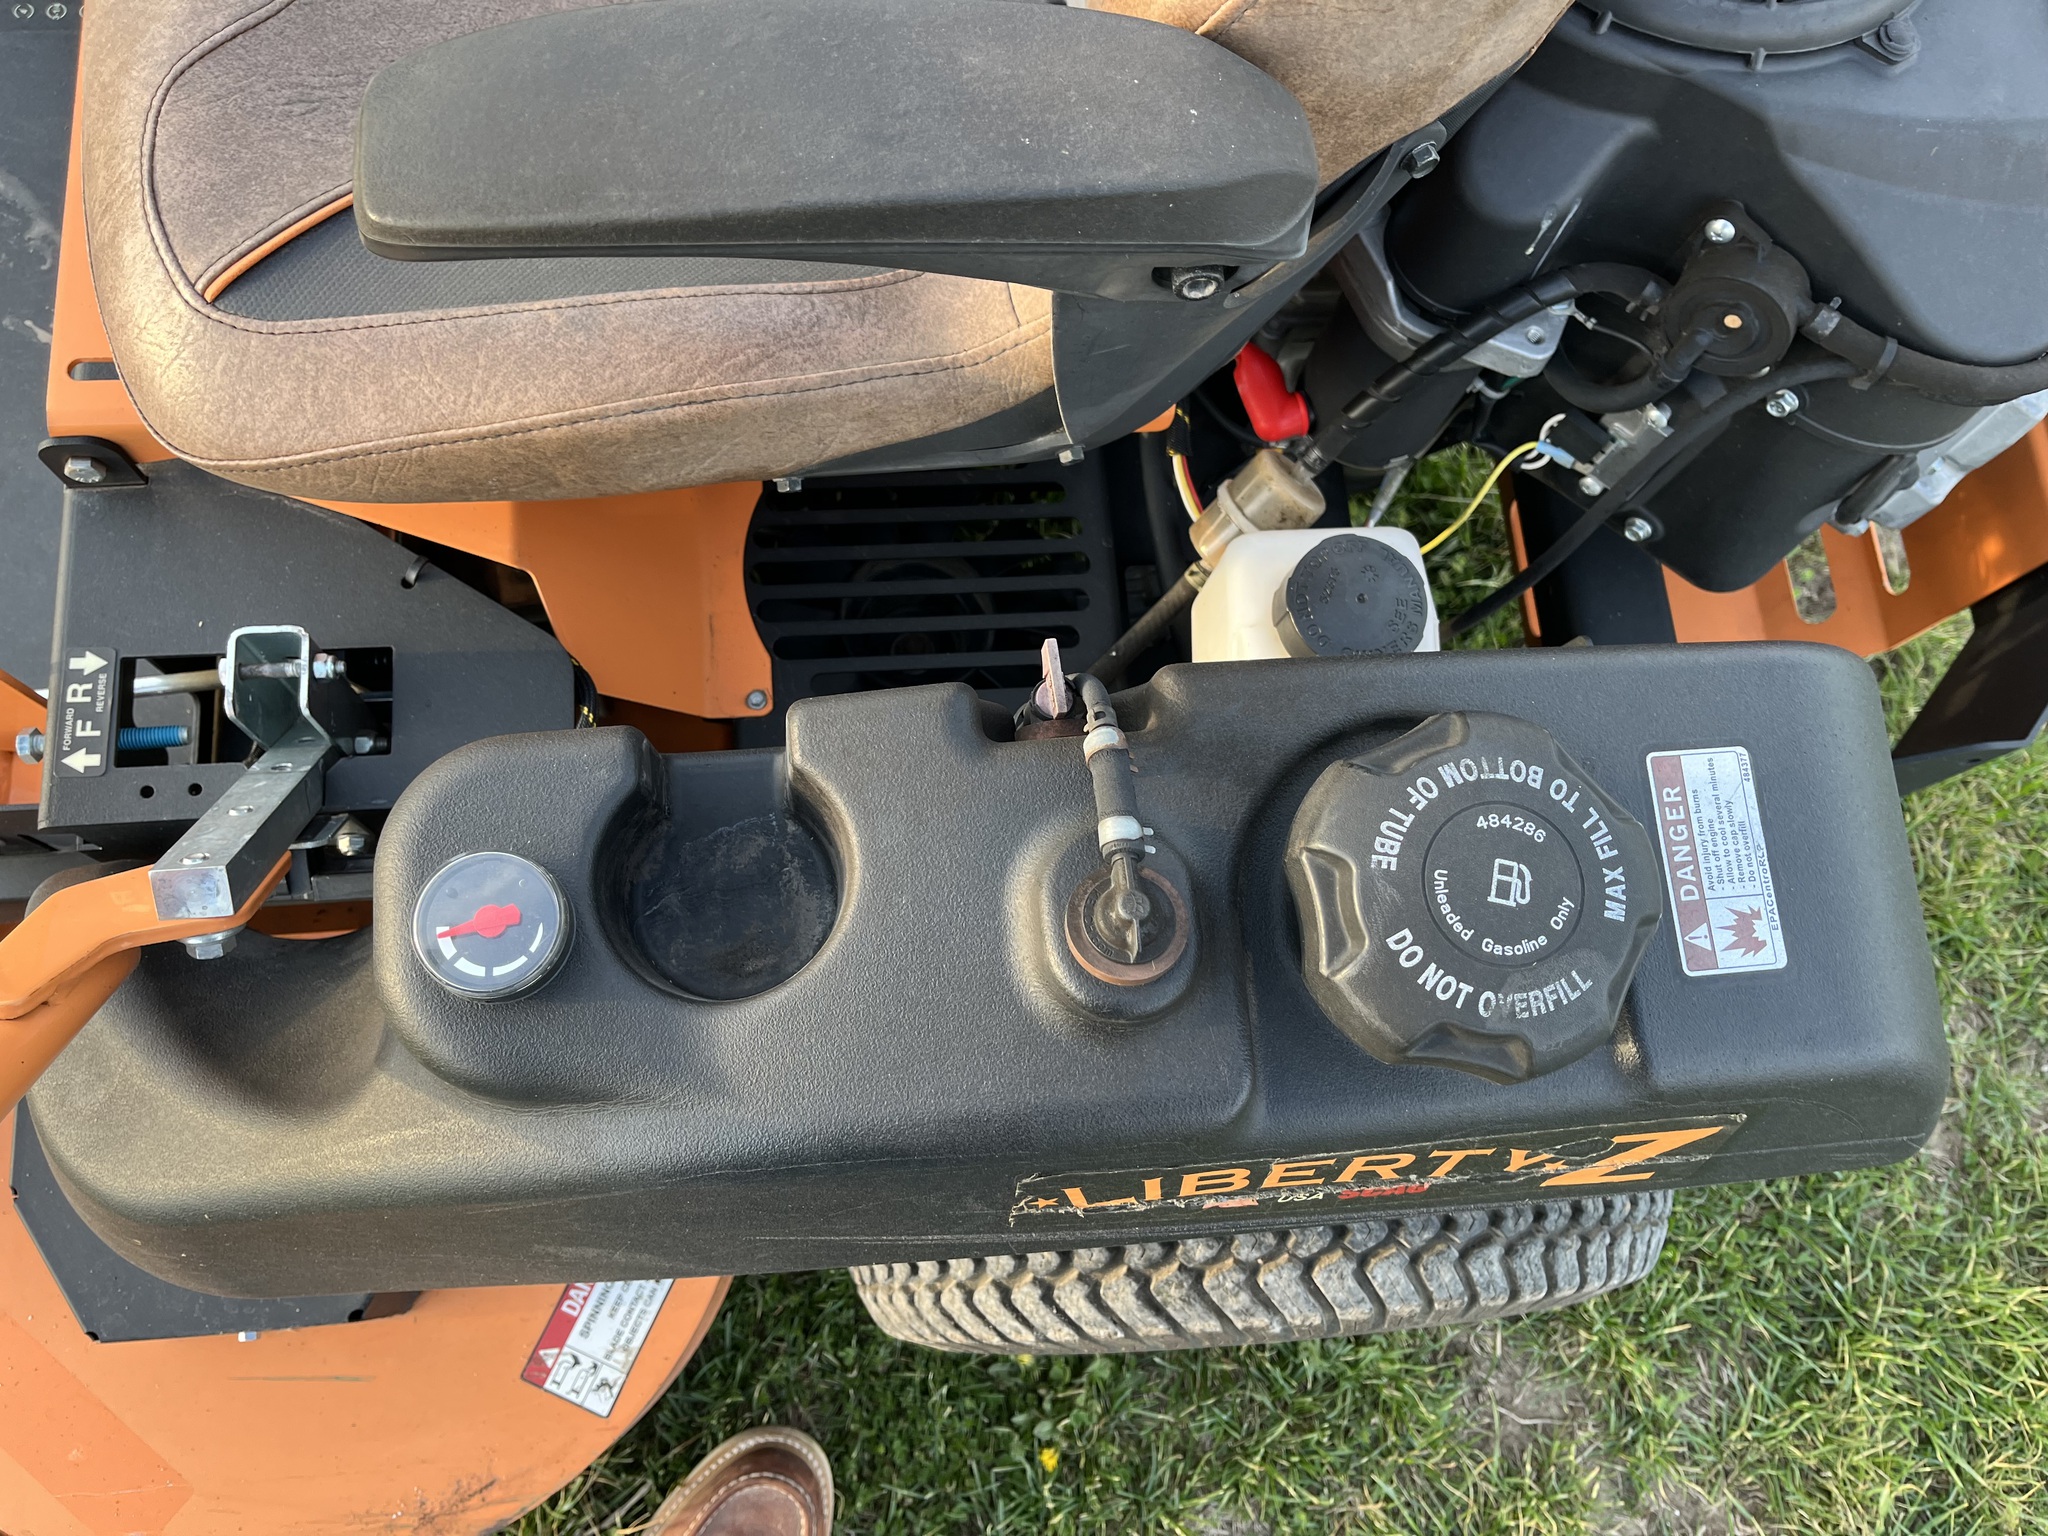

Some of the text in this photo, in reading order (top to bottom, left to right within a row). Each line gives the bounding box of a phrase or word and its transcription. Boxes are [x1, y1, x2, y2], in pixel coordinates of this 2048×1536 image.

[66, 683, 93, 703] R
[96, 673, 107, 712] REVERSE
[63, 708, 74, 751] FORWARD
[75, 719, 101, 737] F
[1738, 752, 1751, 782] 484377
[1371, 756, 1626, 922] MAX FILL TO BOTTOM OF TUBE
[1476, 814, 1547, 843] 484286
[1662, 786, 1700, 901] DANGER
[1690, 788, 1716, 891] Avoid injury from burns
[1705, 757, 1735, 883] Allow to cool several minutes
[1706, 817, 1725, 884] Shut off engine
[1723, 799, 1745, 882] Remove cap slowly
[1737, 820, 1756, 881] Do not overfill
[1432, 869, 1576, 956] Unleaded Gasoline Only
[1385, 927, 1593, 1019] DO NOT OVERFILL
[1062, 1126, 1726, 1210] LIBERTY Z
[1277, 1191, 1325, 1203] USA
